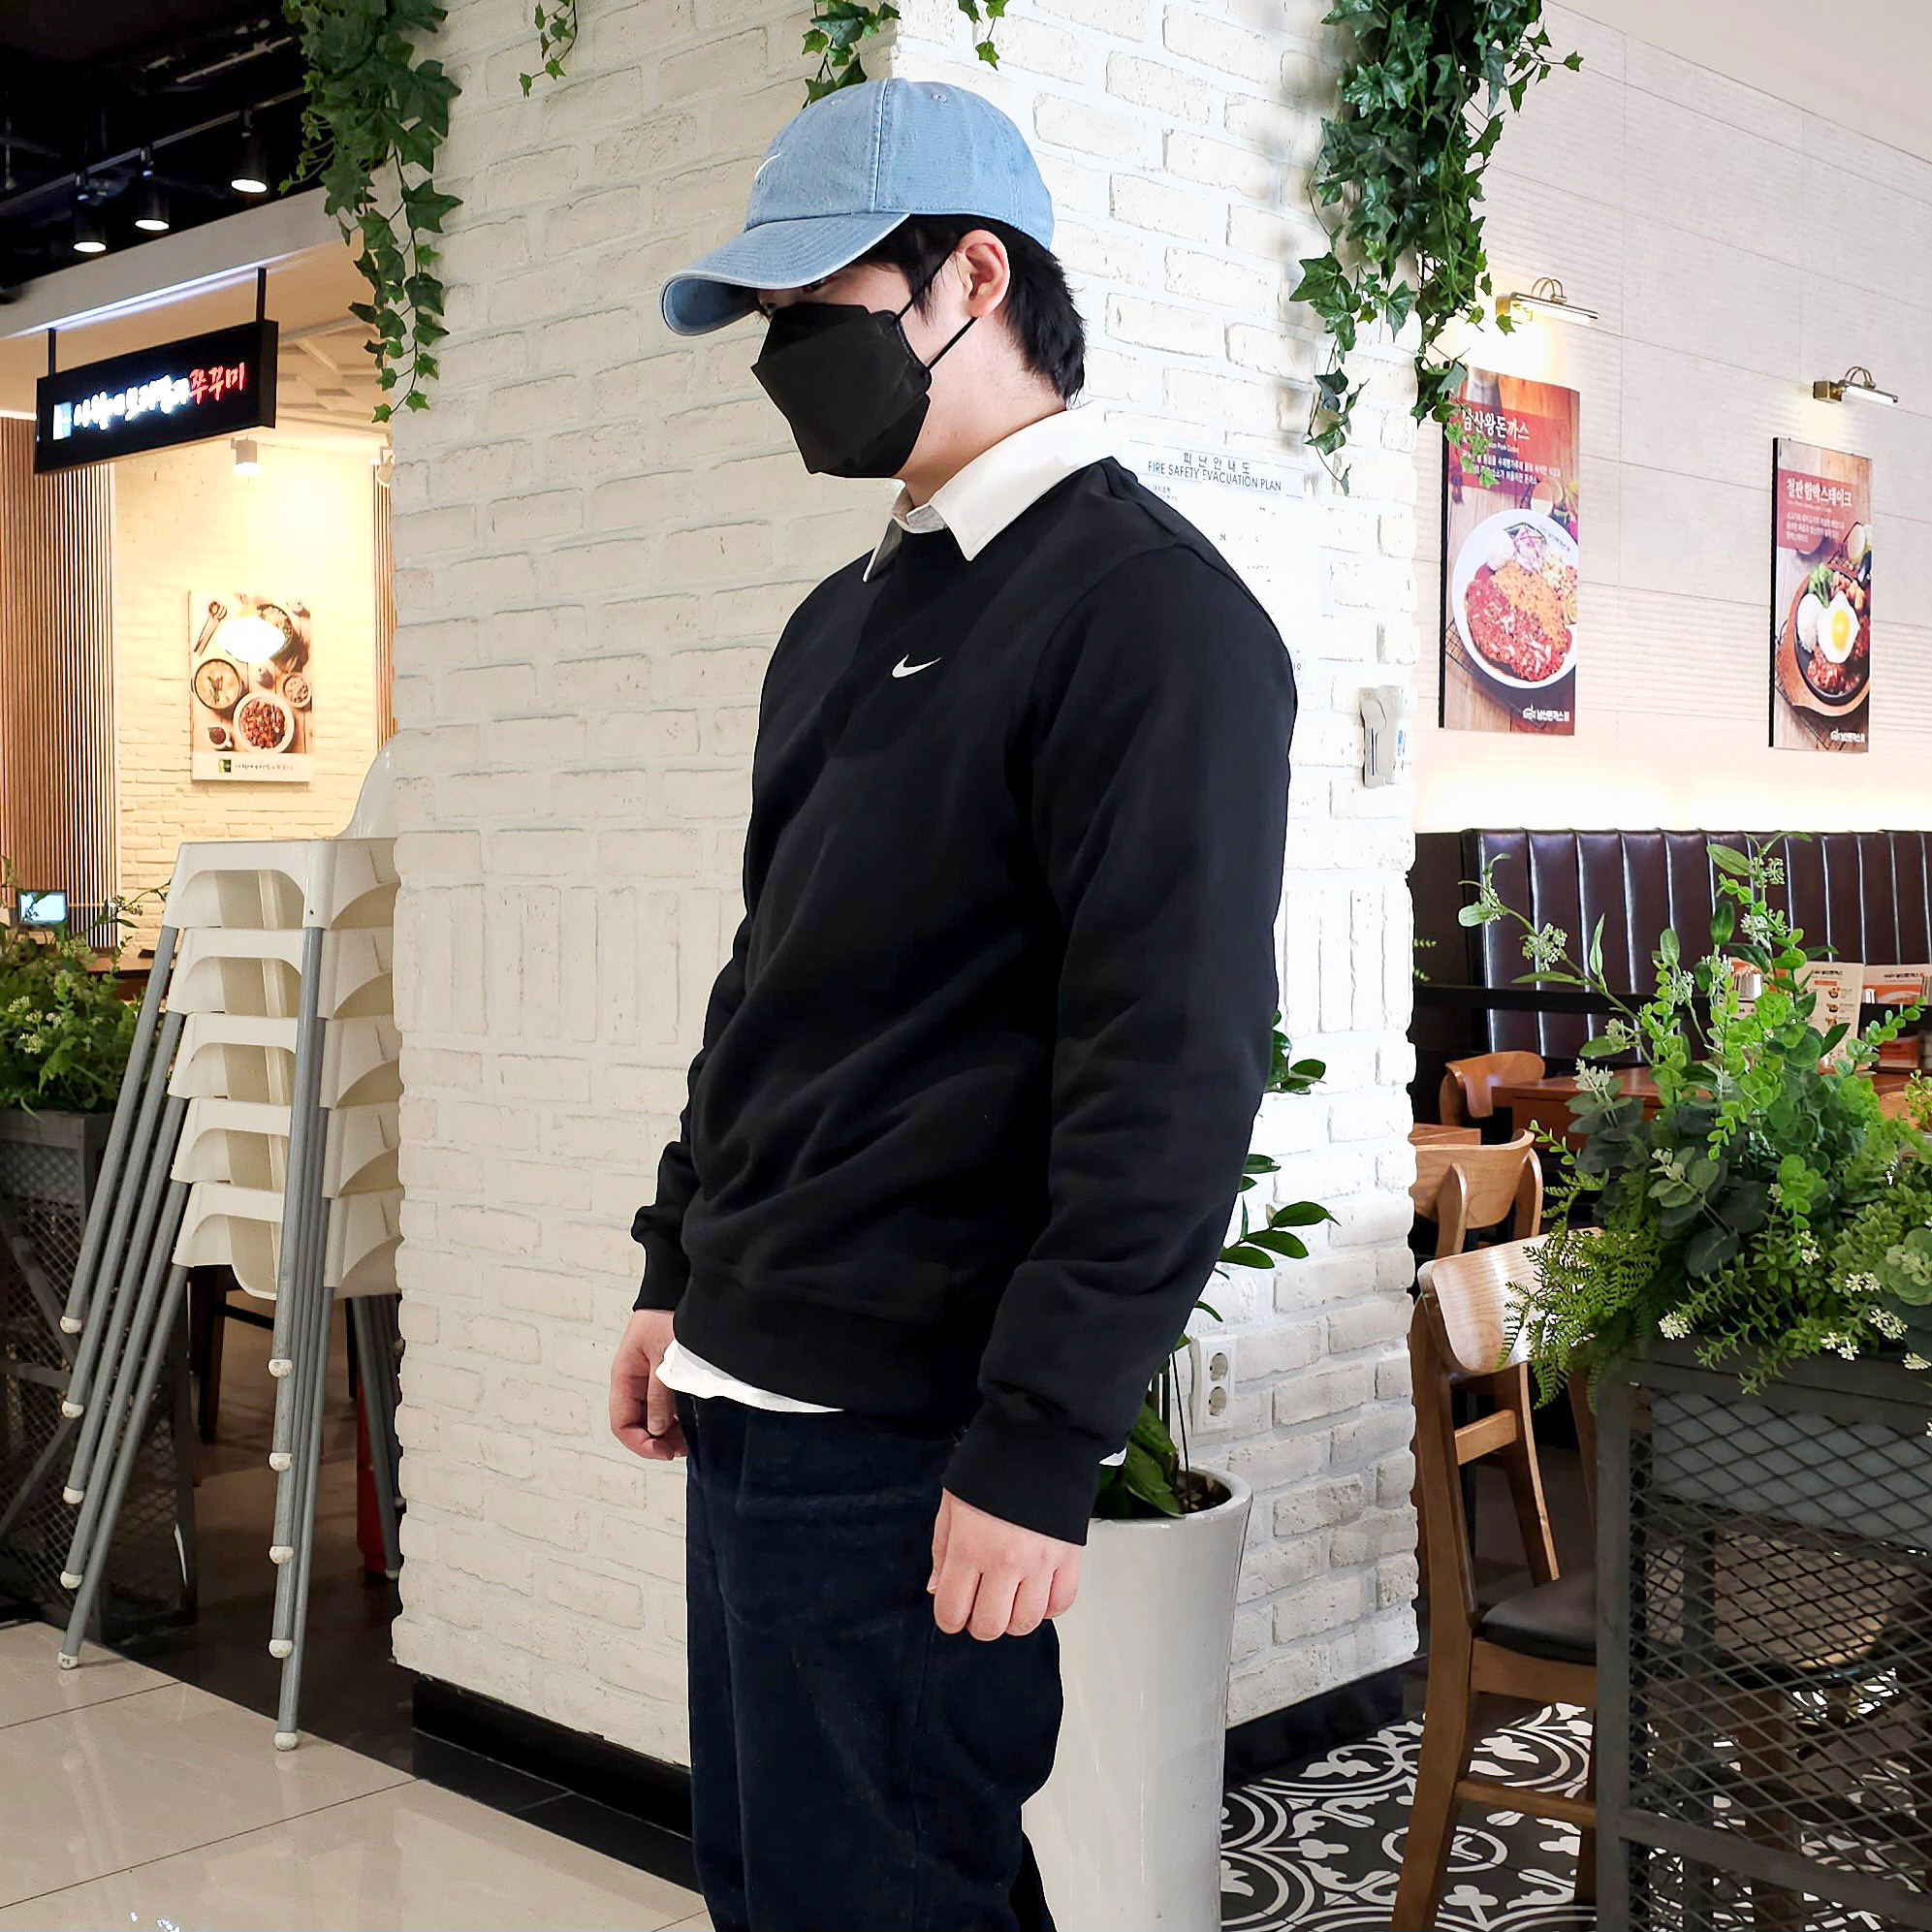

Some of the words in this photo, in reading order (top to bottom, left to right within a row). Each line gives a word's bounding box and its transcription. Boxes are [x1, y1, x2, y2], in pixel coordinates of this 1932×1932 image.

[1148, 460, 1165, 475] FIRE
[1168, 463, 1200, 480] SAFETY
[1202, 468, 1258, 489] EVACUATION
[1260, 478, 1282, 491] PLAN
